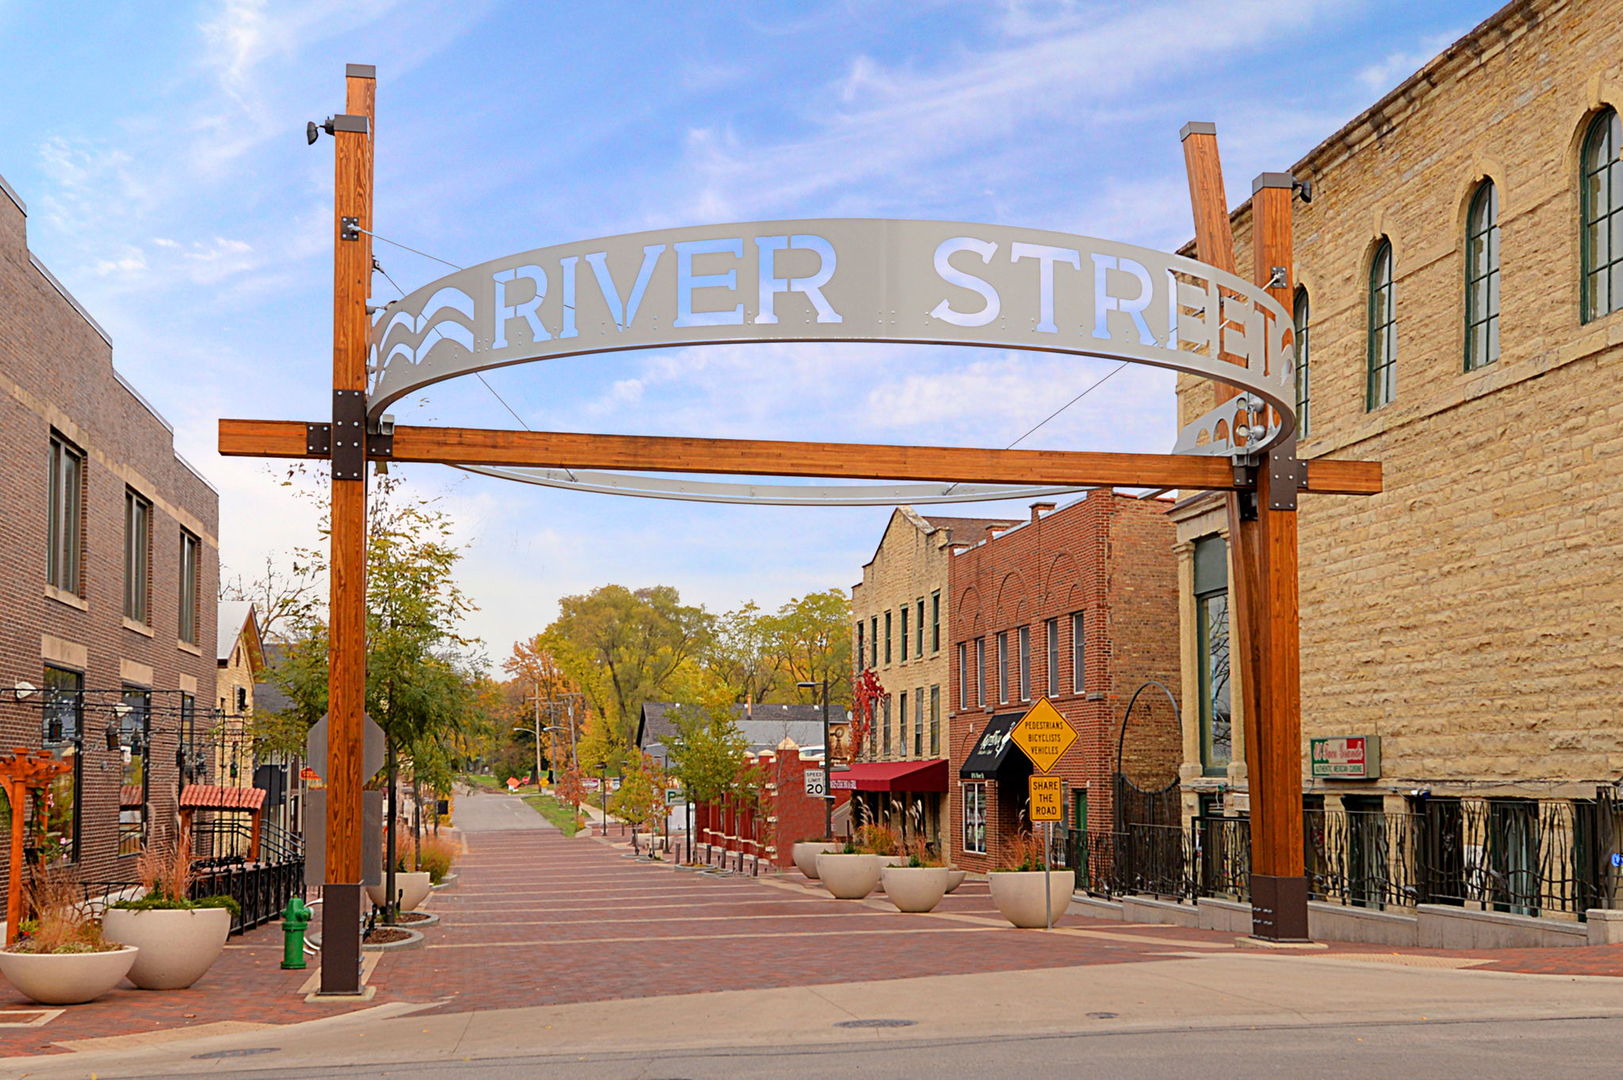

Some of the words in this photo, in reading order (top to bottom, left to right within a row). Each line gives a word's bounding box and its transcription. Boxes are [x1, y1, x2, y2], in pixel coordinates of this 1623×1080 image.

[492, 234, 843, 350] RIVER
[930, 237, 1277, 377] STREET
[1024, 721, 1064, 730] PEDESTRIANS
[1027, 734, 1062, 743] BICYCLISTS
[1031, 746, 1059, 755] VEHICLES
[806, 784, 823, 794] 20
[1033, 781, 1059, 791] SHARE
[1038, 794, 1054, 803] THE
[1035, 806, 1057, 815] ROAD
